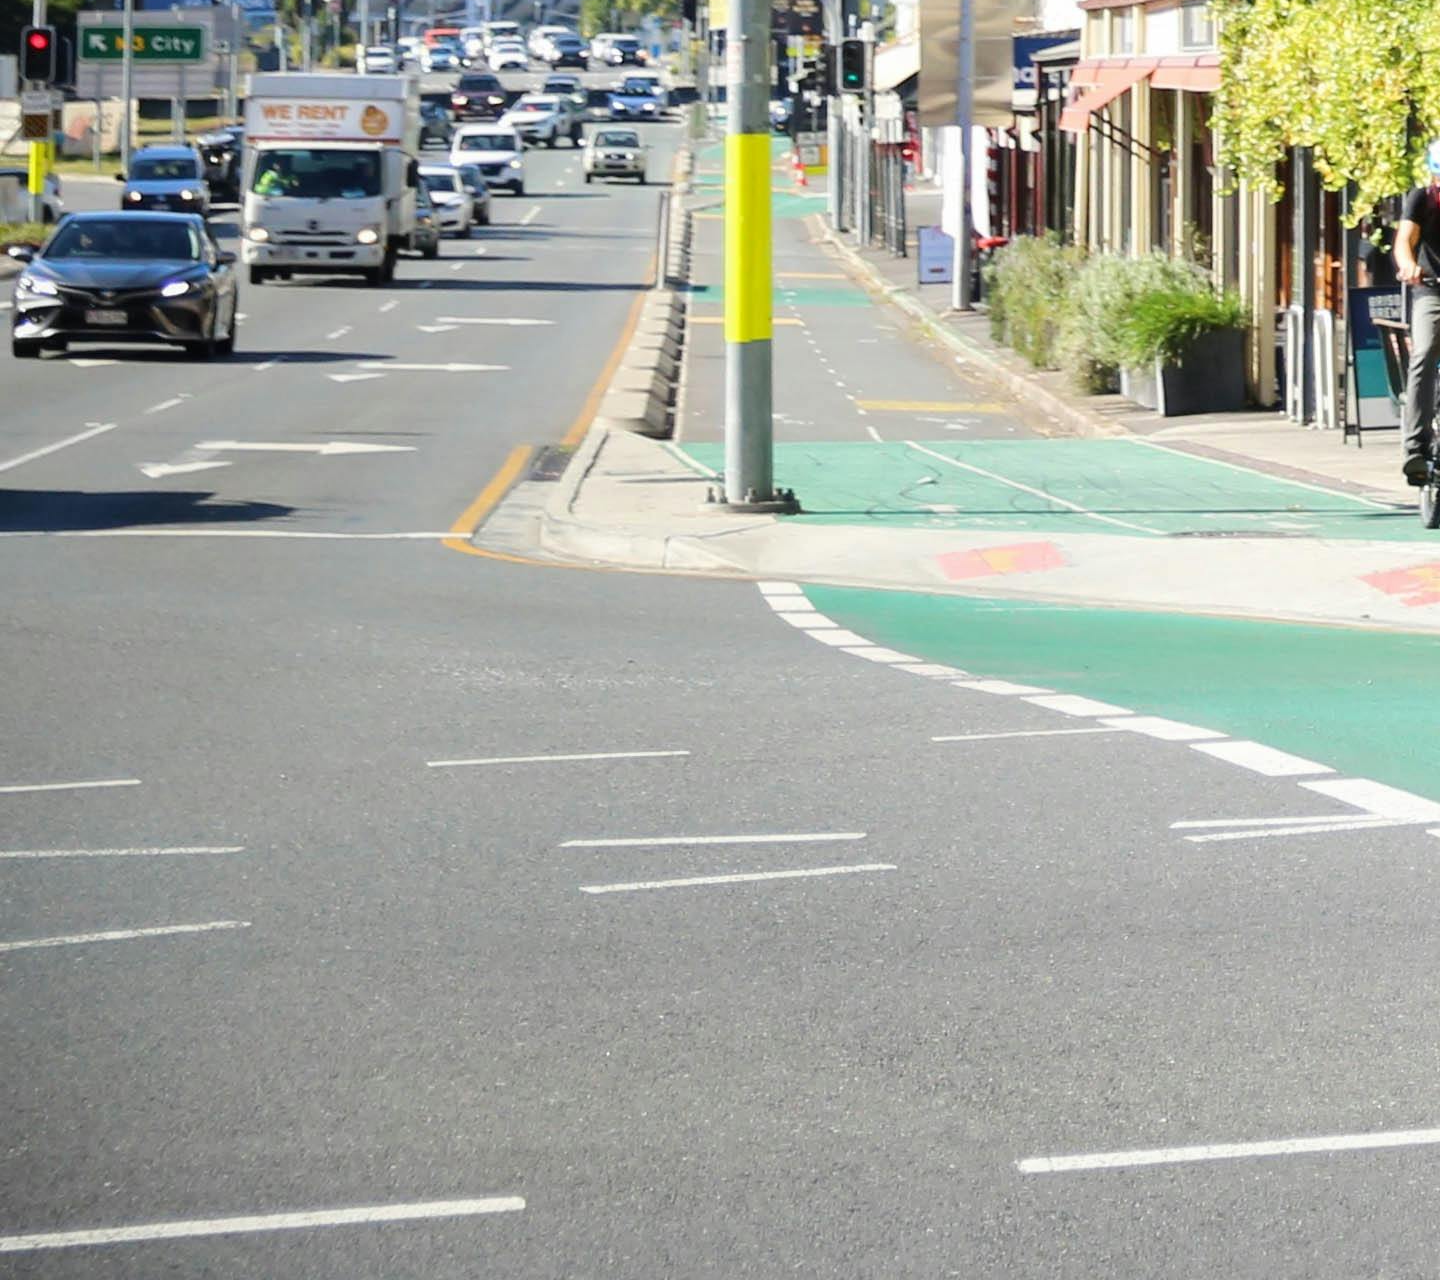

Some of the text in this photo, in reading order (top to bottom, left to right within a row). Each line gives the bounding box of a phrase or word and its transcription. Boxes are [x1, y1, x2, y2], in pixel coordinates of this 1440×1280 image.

[150, 35, 194, 55] City
[262, 105, 348, 120] WE RENT
